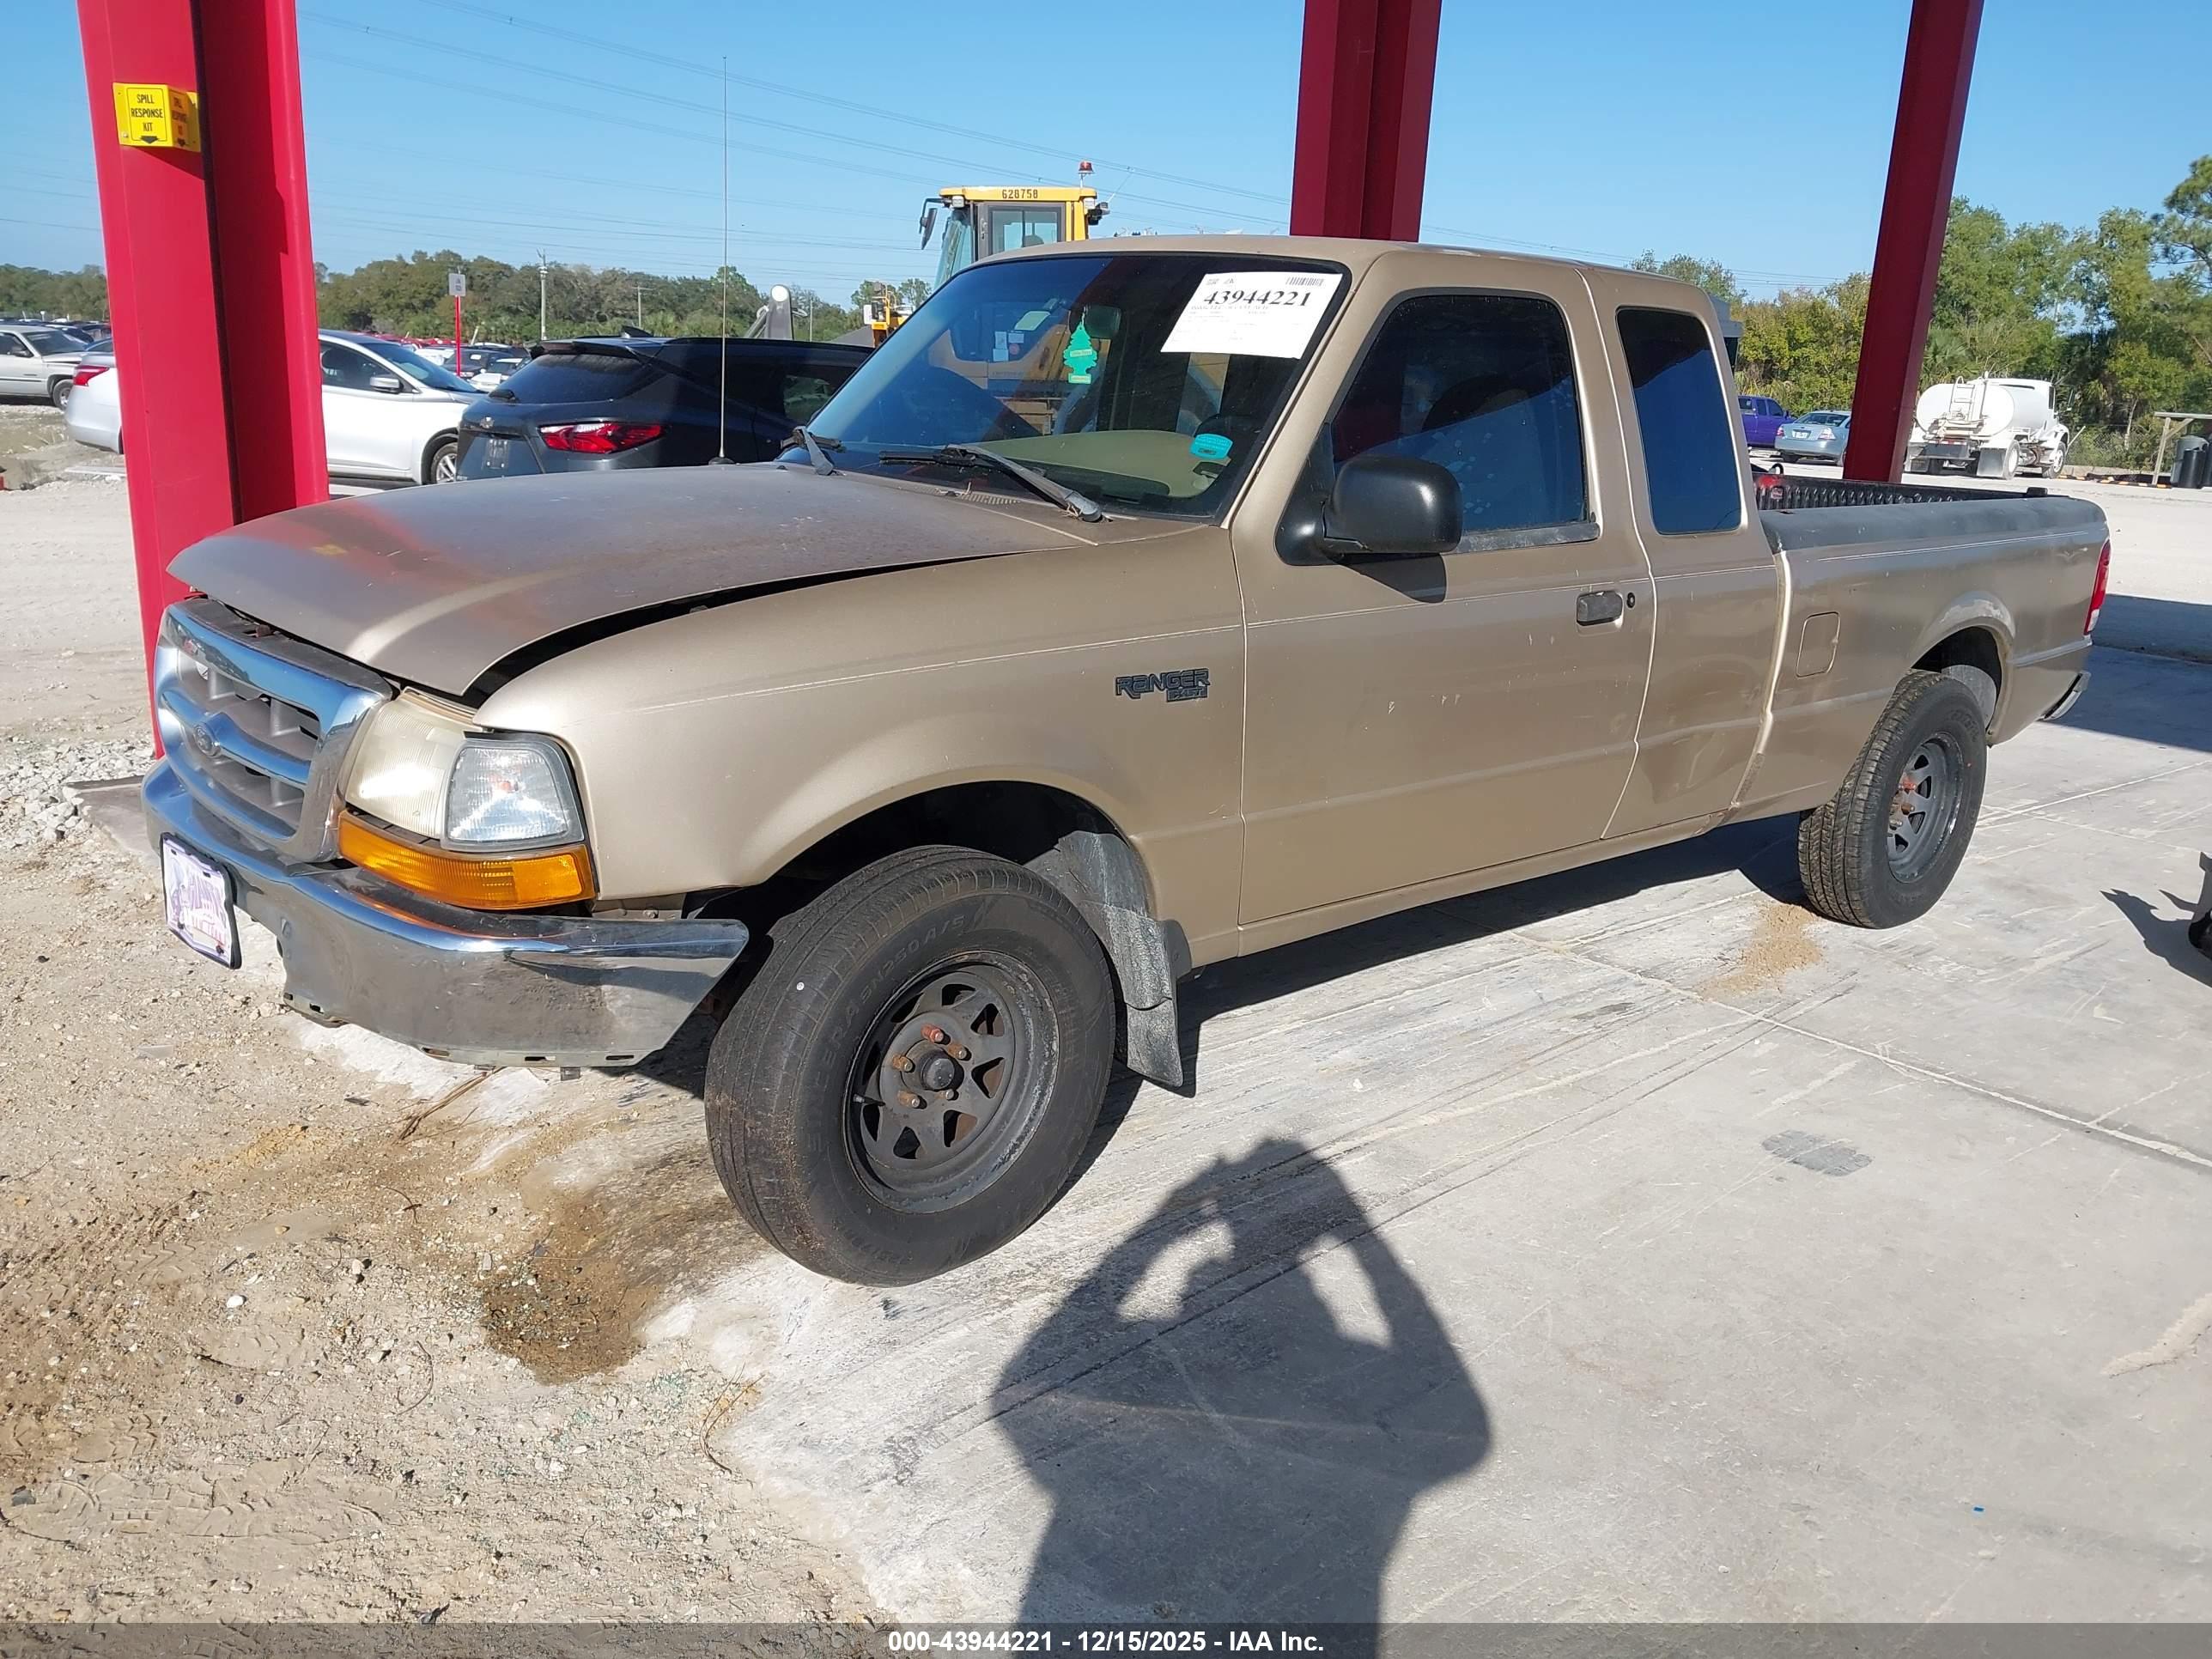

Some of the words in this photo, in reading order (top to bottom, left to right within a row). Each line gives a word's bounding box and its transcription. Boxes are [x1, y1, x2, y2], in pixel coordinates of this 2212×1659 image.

[137, 94, 155, 104] SPILL
[131, 107, 163, 118] RESPONSE
[143, 122, 154, 131] KIT
[1204, 289, 1311, 307] 43944221
[1115, 668, 1210, 699] RANGER
